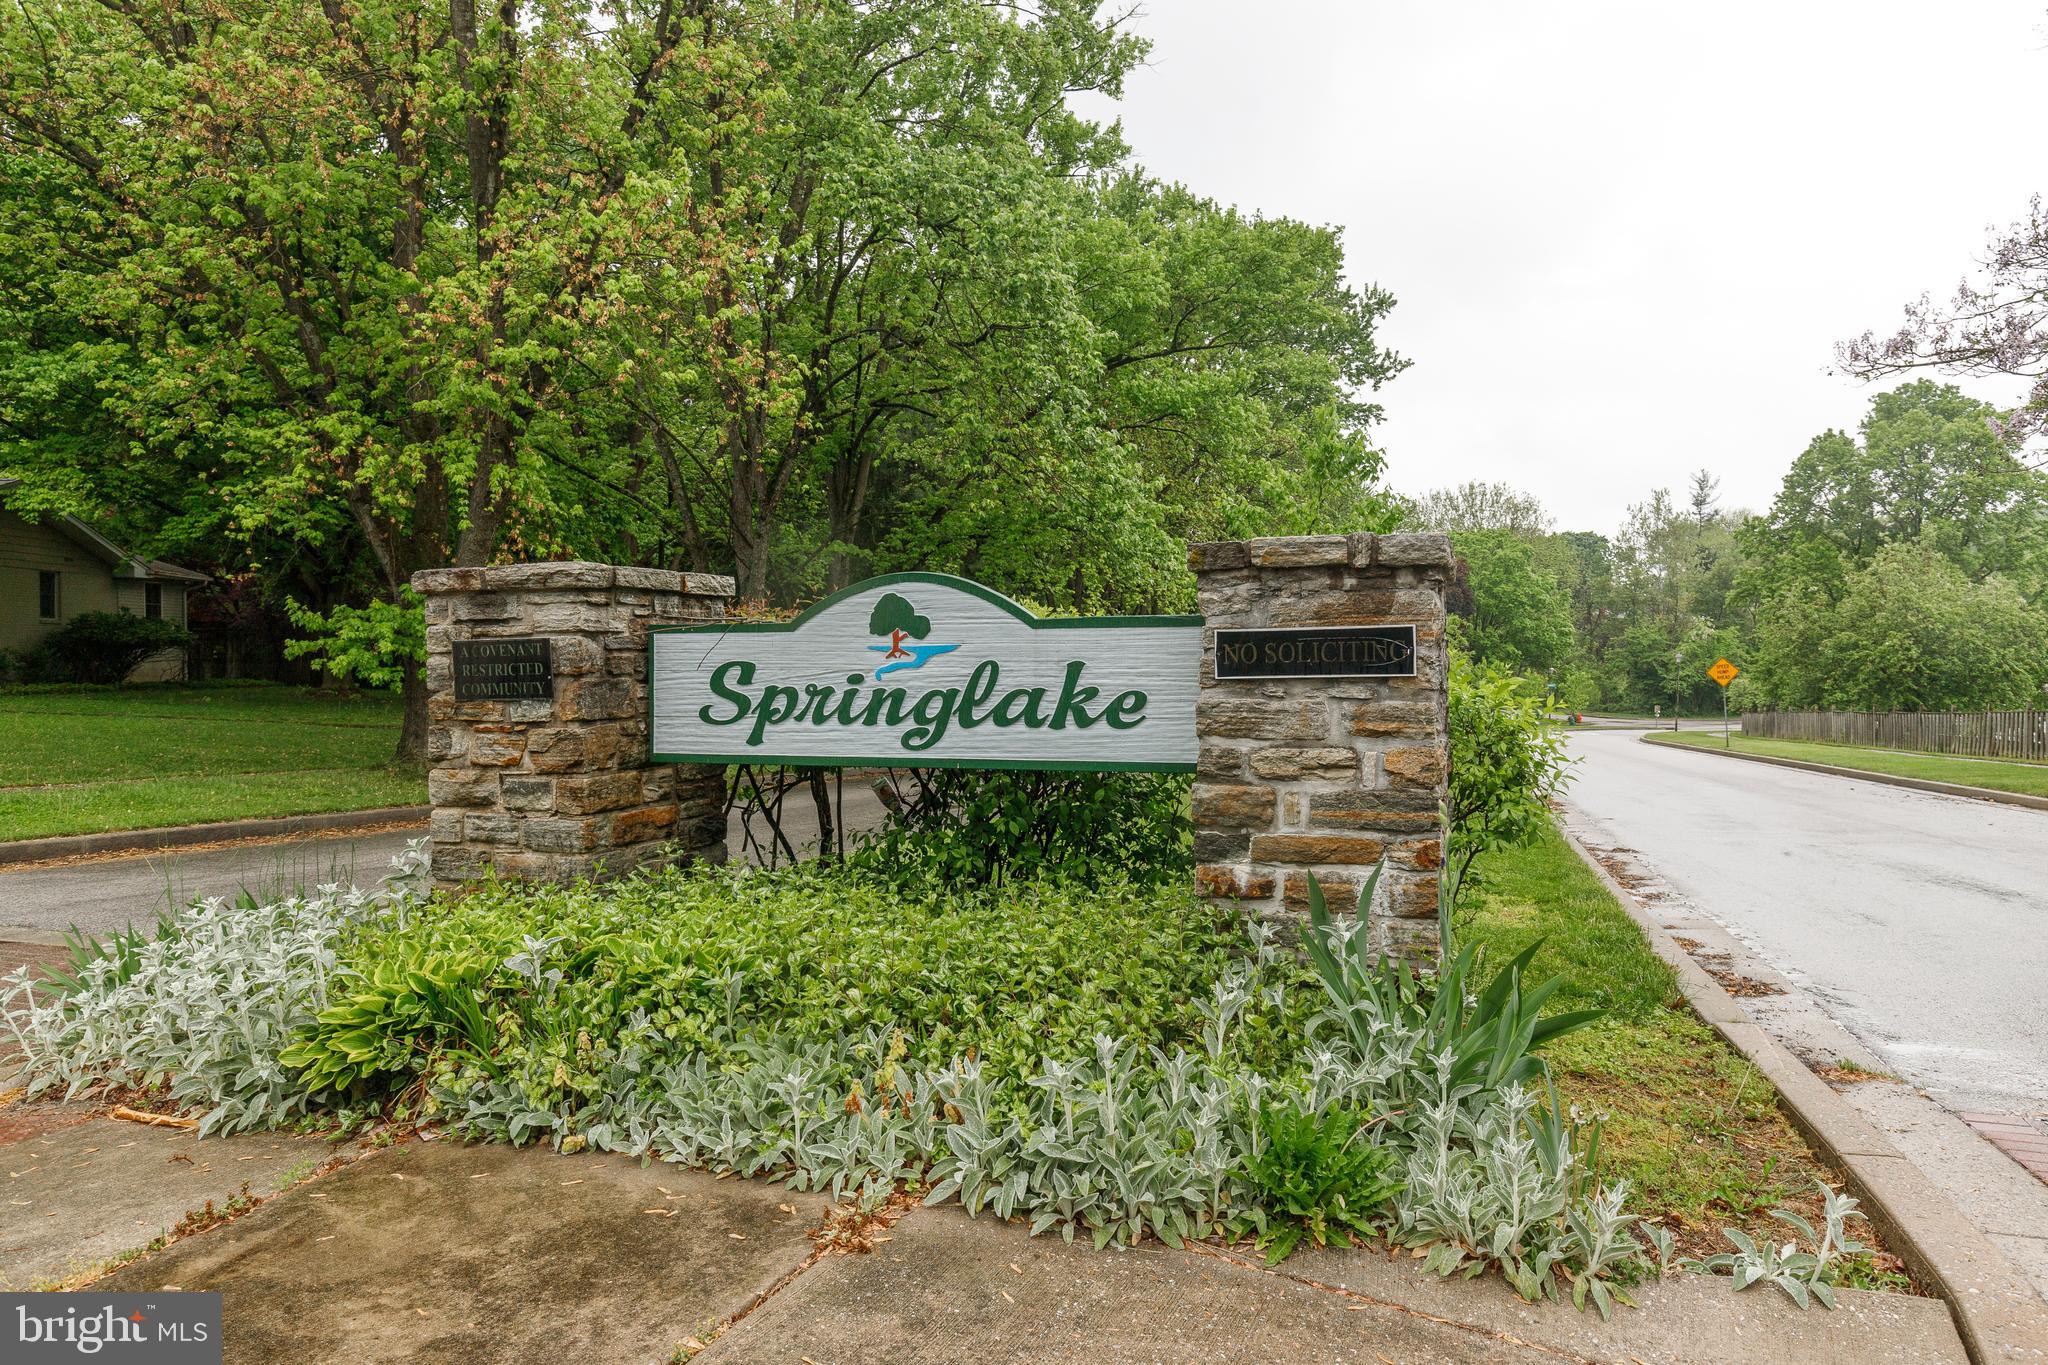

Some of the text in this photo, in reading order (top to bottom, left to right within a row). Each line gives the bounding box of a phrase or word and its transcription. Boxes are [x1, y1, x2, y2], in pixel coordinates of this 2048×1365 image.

[460, 643, 543, 658] A COVENANT
[1223, 639, 1406, 665] NO SOLICITING
[463, 663, 544, 676] RESTRICTED
[462, 682, 545, 695] COMMUNITY
[699, 660, 1148, 751] Springlake
